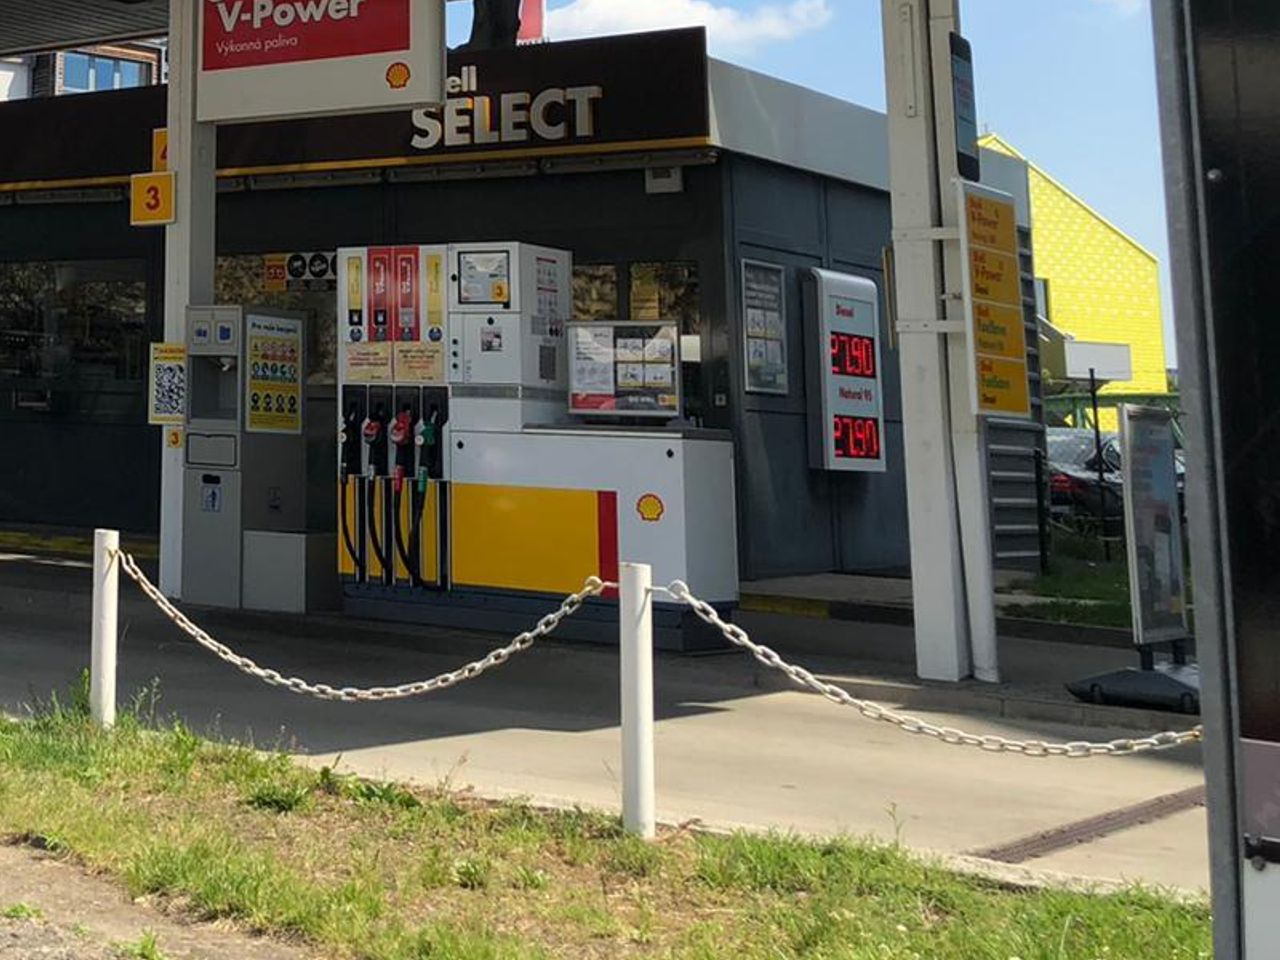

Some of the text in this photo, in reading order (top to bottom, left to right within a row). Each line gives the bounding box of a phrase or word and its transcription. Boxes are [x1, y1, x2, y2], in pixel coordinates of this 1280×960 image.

[264, 35, 298, 54] paliva
[444, 65, 477, 93] ell
[410, 85, 603, 150] SELECT
[145, 185, 160, 211] 3
[171, 432, 179, 444] 3
